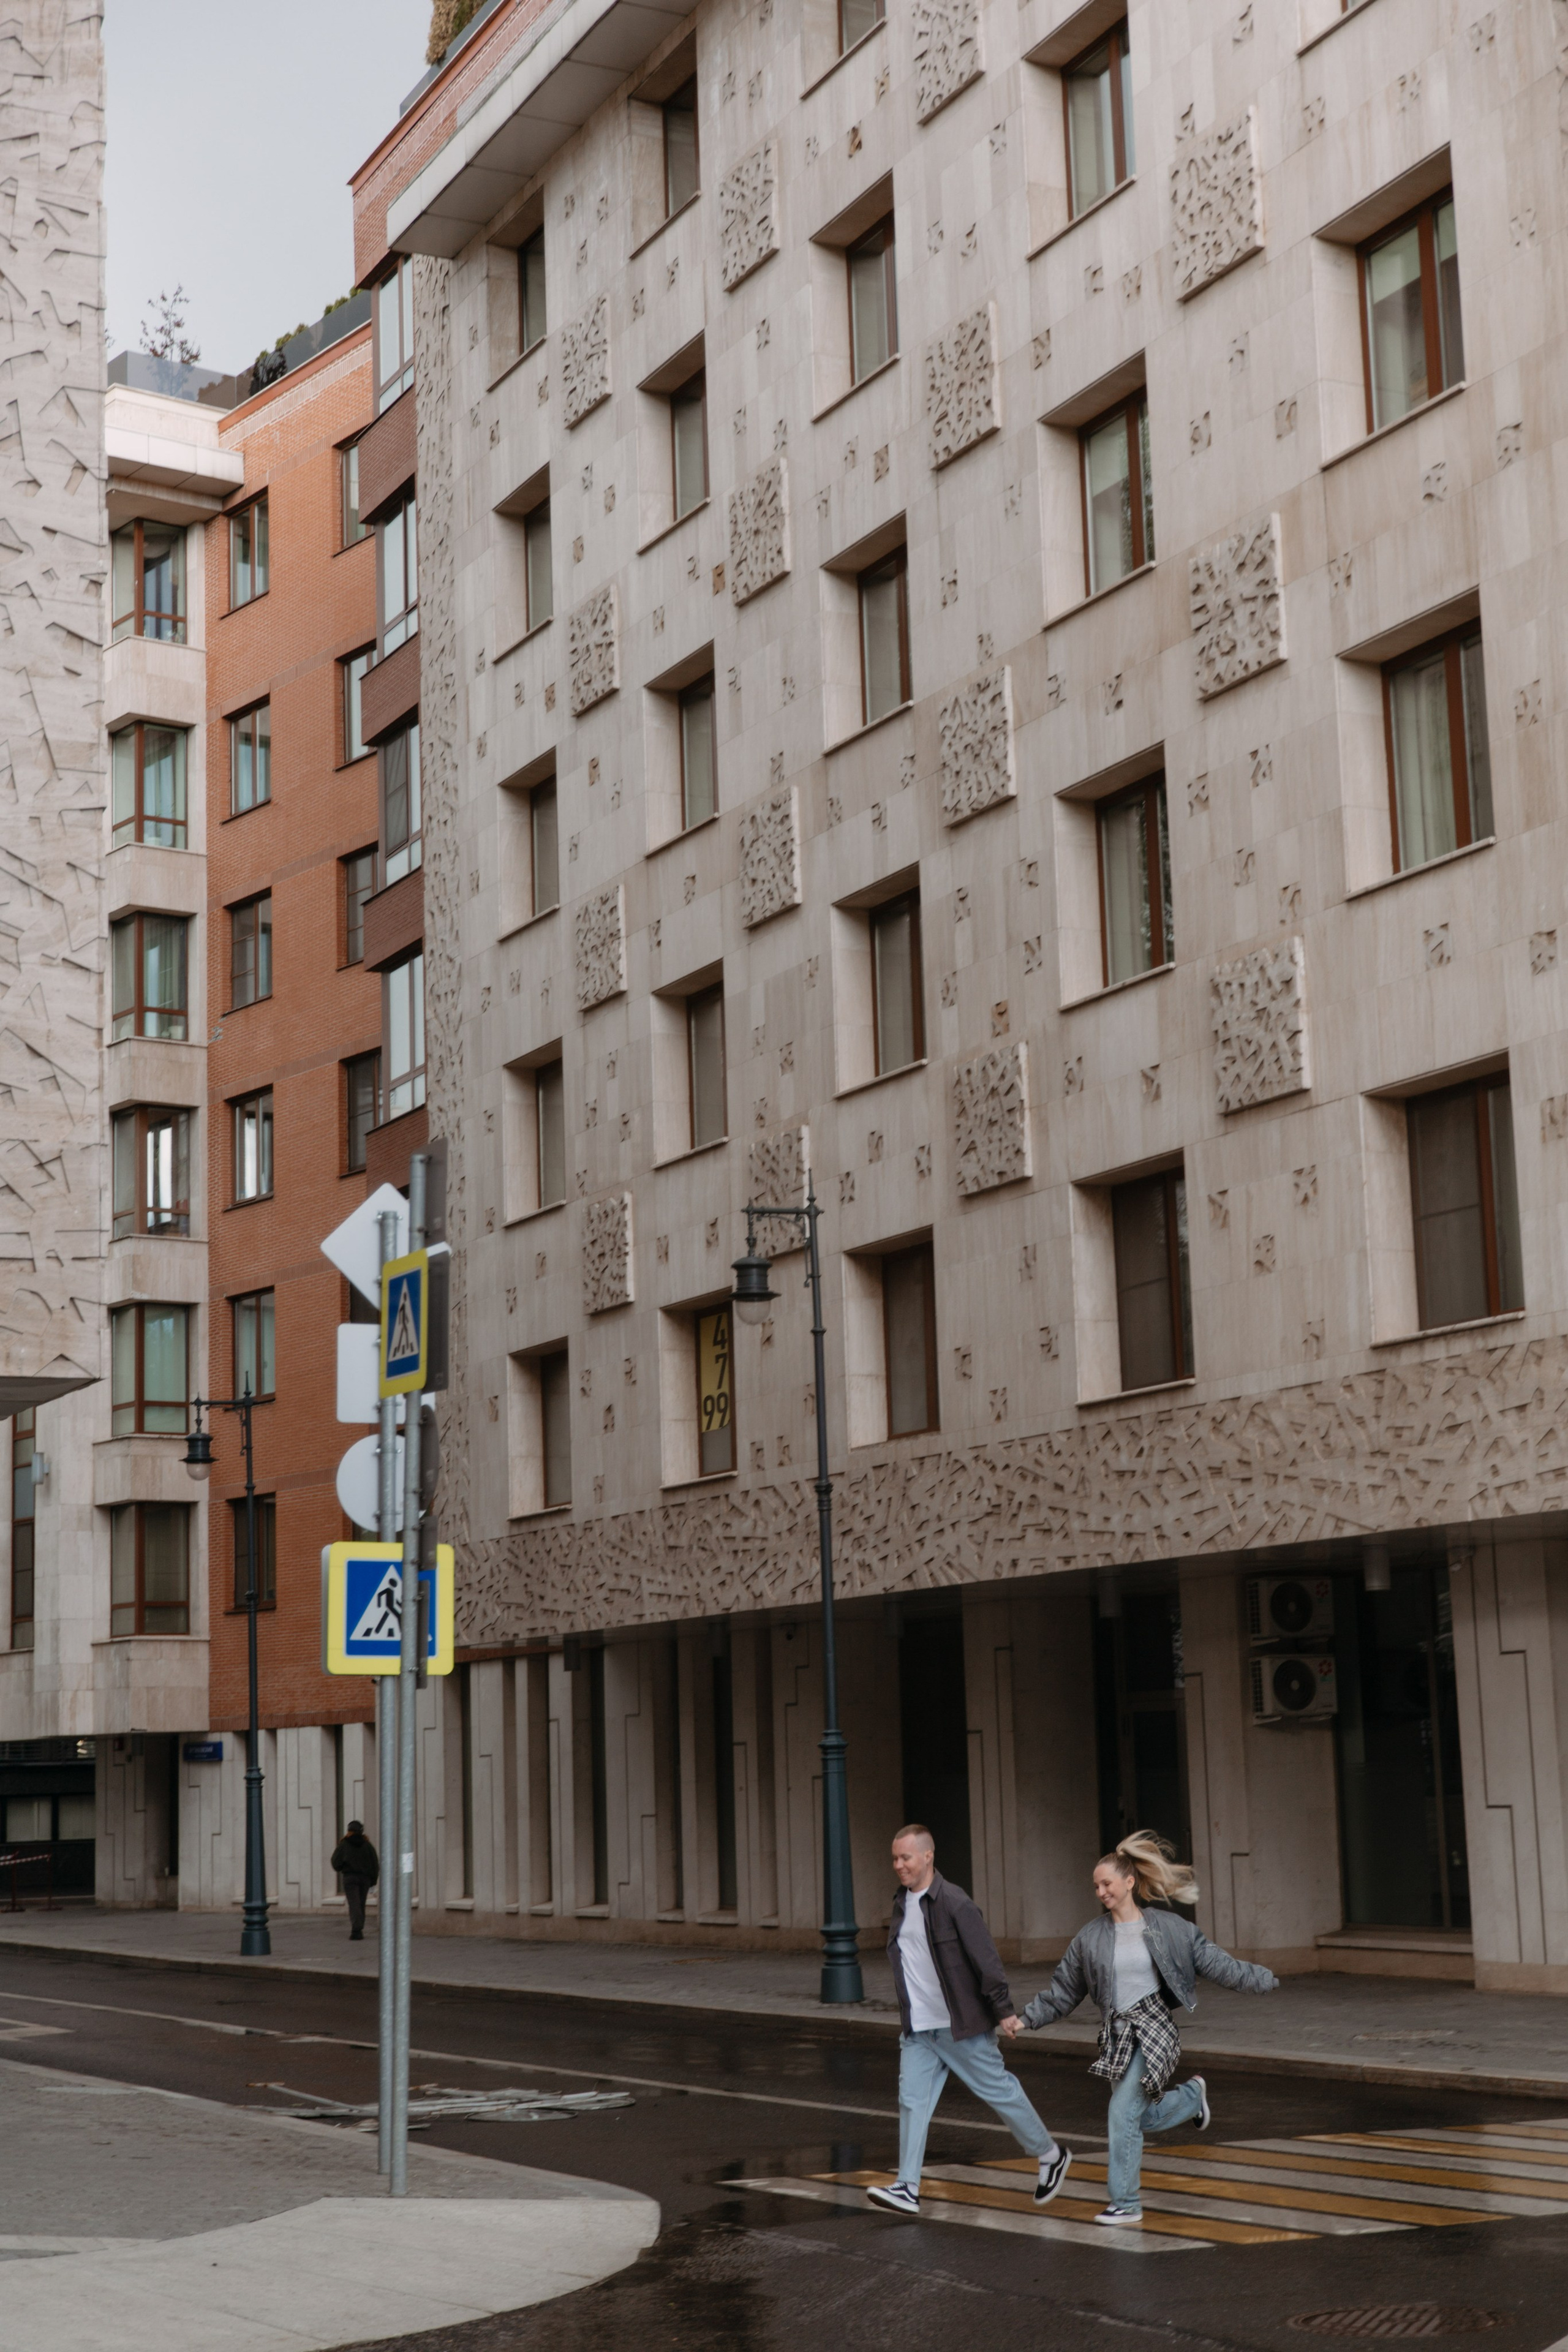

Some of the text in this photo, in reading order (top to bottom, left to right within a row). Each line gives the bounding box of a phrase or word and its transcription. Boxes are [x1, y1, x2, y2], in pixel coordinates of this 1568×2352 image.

[712, 1314, 727, 1350] 4
[715, 1353, 728, 1390] 7
[703, 1392, 728, 1431] 99
